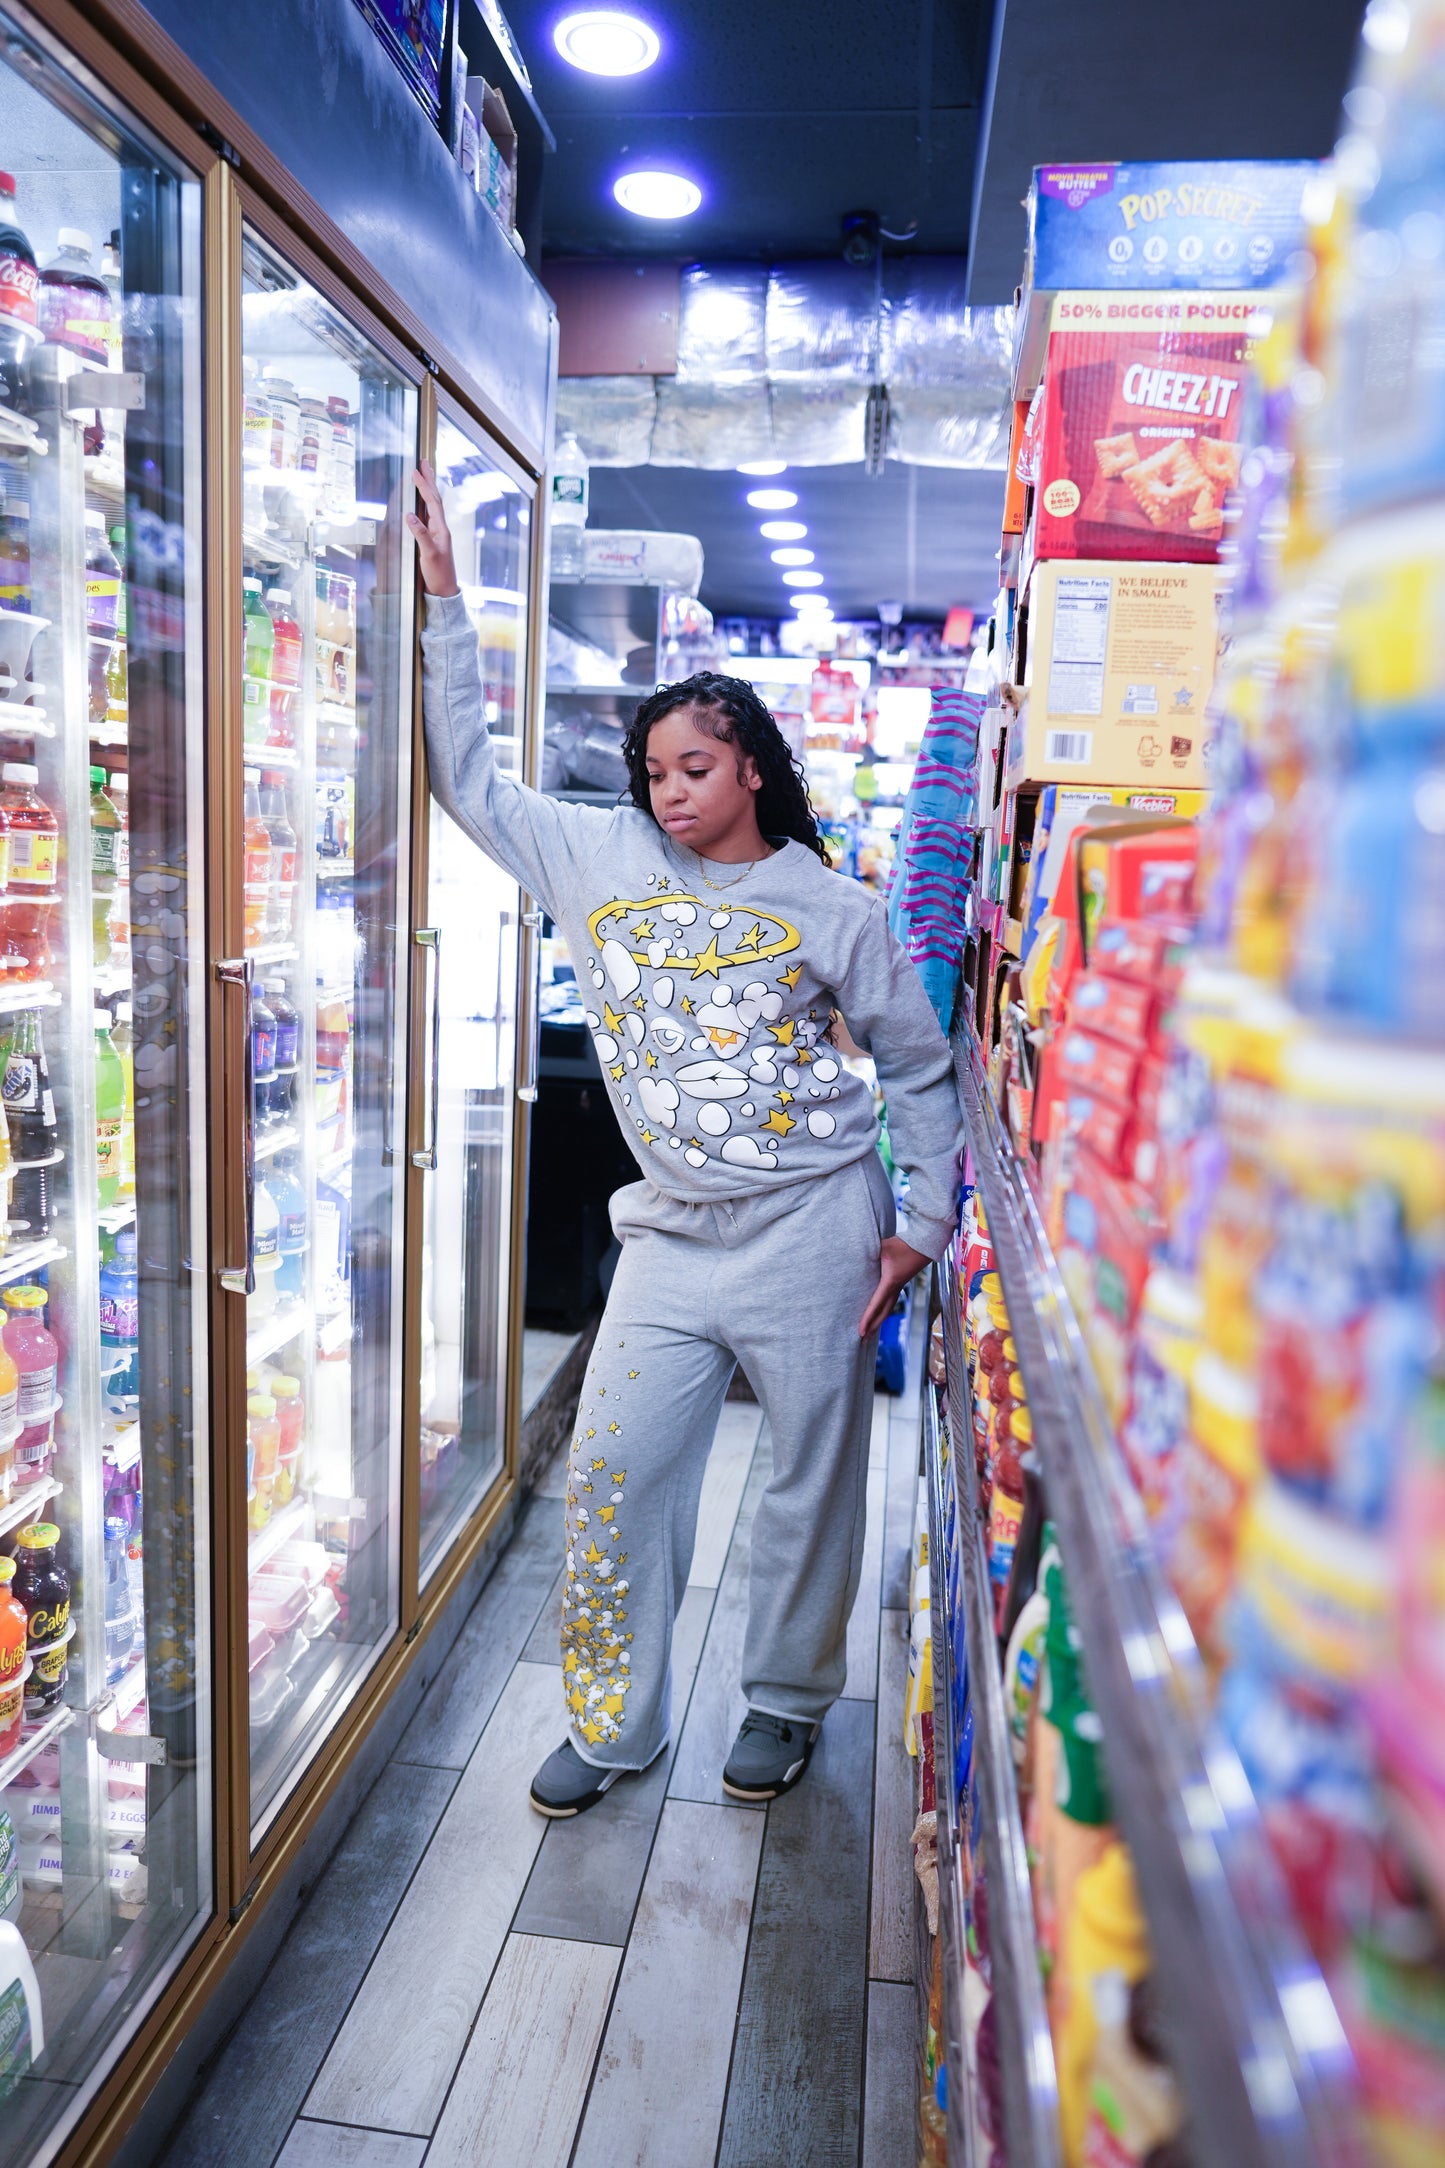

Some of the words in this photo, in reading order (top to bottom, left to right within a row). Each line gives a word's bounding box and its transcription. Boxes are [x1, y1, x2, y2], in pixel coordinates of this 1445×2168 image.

[1058, 180, 1097, 190] BUTTER
[1060, 304, 1102, 319] 50%
[1107, 304, 1182, 319] BIGGER
[1139, 426, 1197, 439] ORIGINAL
[1058, 579, 1089, 587] Nutrition
[1090, 580, 1110, 588] Facts
[1118, 577, 1138, 587] WE
[1139, 577, 1189, 589] BELIEVE
[1117, 588, 1130, 598] IN
[1131, 589, 1171, 599] SMALL
[1132, 795, 1172, 813] Keebler
[32, 1804, 61, 1816] JUMB
[120, 1813, 146, 1824] EGGS
